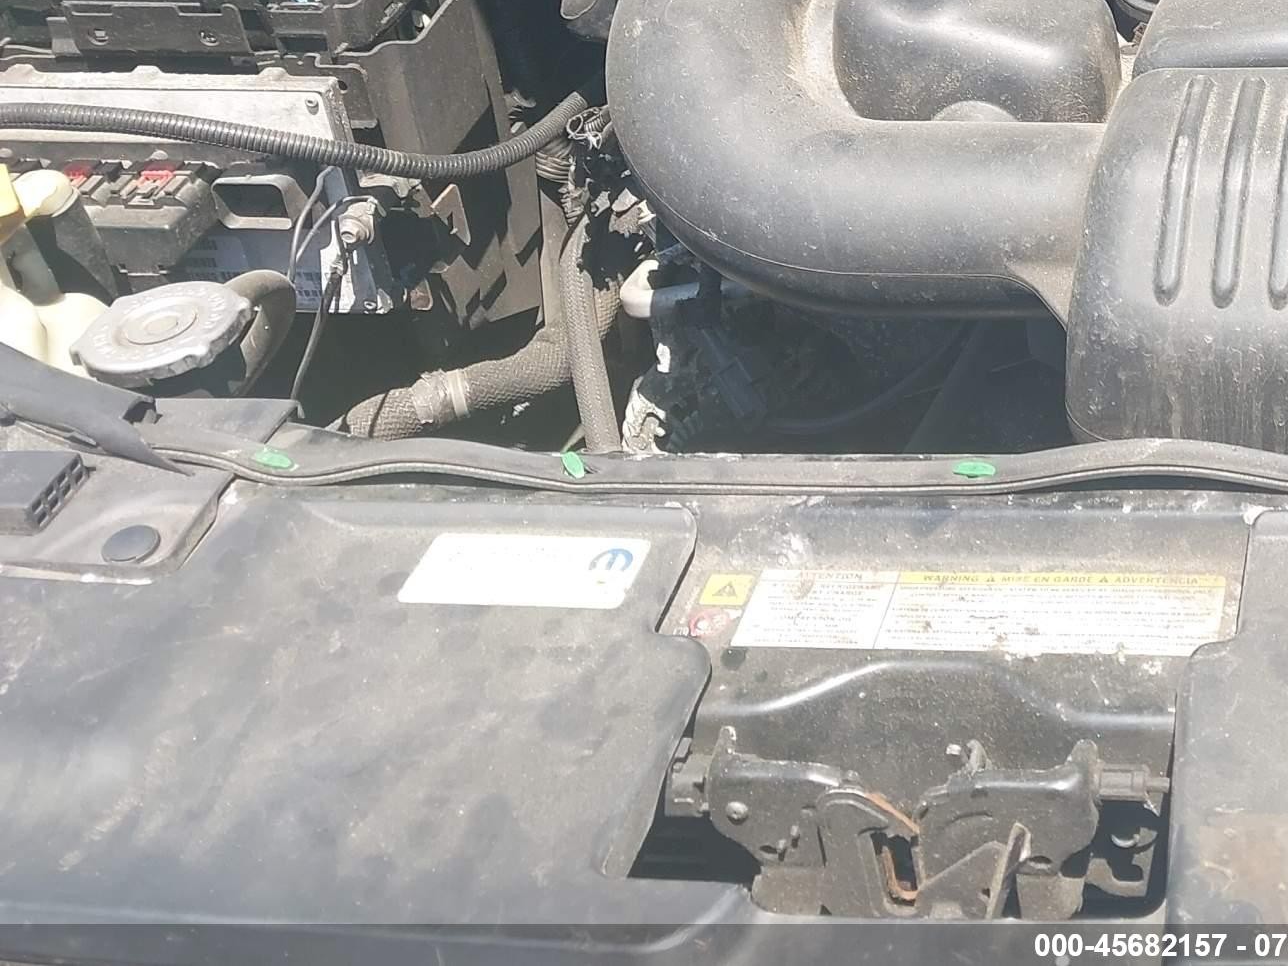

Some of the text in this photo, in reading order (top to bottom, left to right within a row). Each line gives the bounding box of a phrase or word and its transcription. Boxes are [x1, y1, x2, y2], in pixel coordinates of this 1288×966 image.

[923, 575, 1199, 585] WARNING MISE EN GARDE ADVERTENCIA
